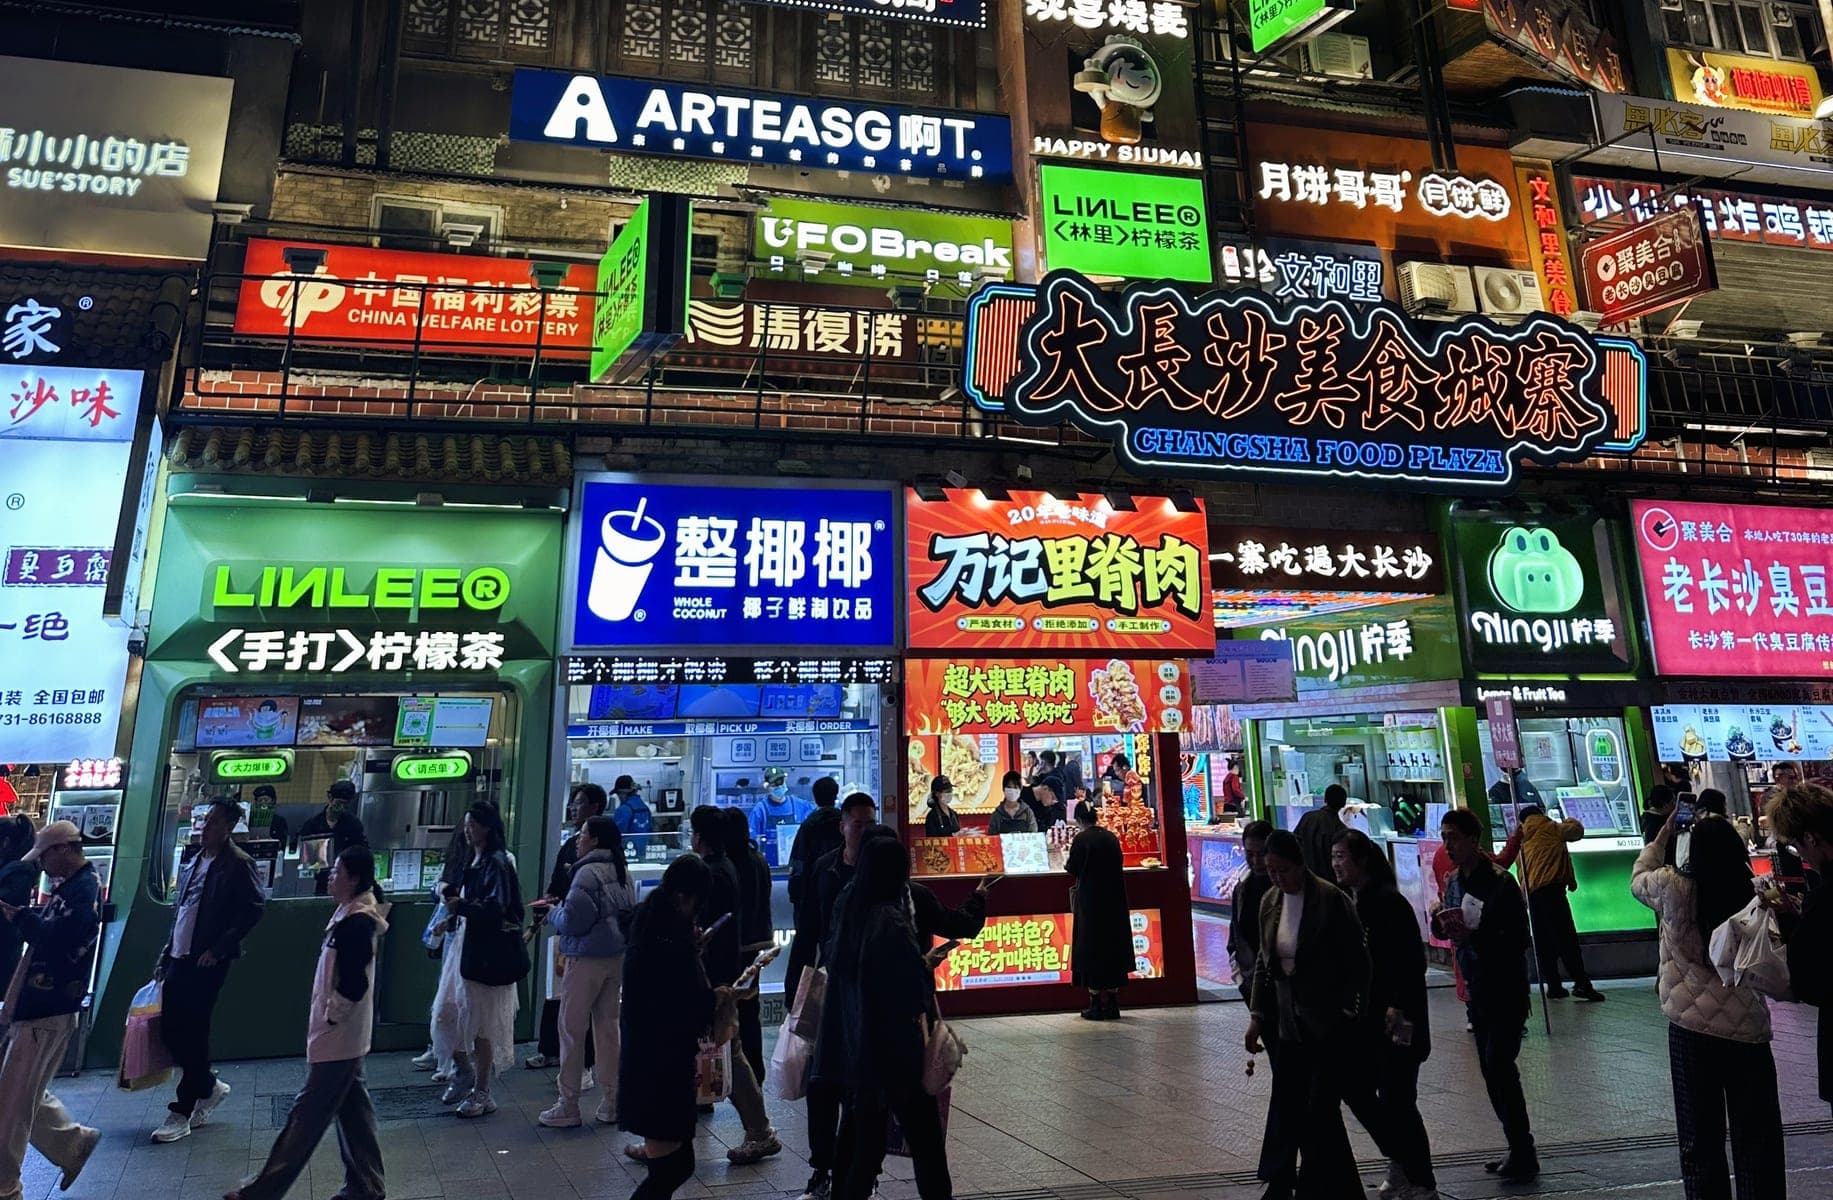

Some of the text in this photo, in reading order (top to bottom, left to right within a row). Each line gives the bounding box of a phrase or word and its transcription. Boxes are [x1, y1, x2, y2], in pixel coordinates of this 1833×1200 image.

[636, 88, 892, 151] ARTEASG
[1033, 136, 1201, 170] HAPPY SIUMAI
[1258, 161, 1405, 213] 月饼哥哥
[1529, 176, 1571, 316] 文和里美食
[1615, 234, 1673, 276] 聚美合
[1273, 252, 1383, 302] 文和里
[1602, 260, 1684, 305] 老长沙臭豆腐
[353, 270, 581, 320] 中国福利彩票
[2, 298, 61, 359] 家
[348, 309, 580, 337] CHINA WELFARE LOTTERY
[1030, 290, 1600, 442] 大長沙美食城寨
[10, 377, 121, 428] 沙味
[1134, 428, 1506, 474] CHANGSHA FOOD PLAZA
[1681, 520, 1734, 543] 聚美合
[674, 516, 873, 589] 整椰椰
[1208, 539, 1434, 580] 一寨吃遍大长沙
[920, 532, 1201, 615] 万记里脊肉
[1661, 556, 1833, 618] 老长沙臭豆
[672, 607, 728, 620] COCONUT
[673, 597, 713, 608] WHOLE
[742, 595, 873, 621] 椰子鲜制饮品
[967, 618, 1013, 629] 严选食材
[1044, 618, 1088, 630] 拒绝添加
[1117, 620, 1161, 631] 手工制作
[1571, 618, 1617, 644] 柠季
[1688, 629, 1833, 652] 长沙第一代臭豆腐传
[1361, 619, 1413, 664] 柠季
[33, 689, 105, 705] 全国包邮
[942, 663, 1076, 700] 超大串里脊肉
[1512, 686, 1522, 700] &
[1522, 686, 1547, 701] Fruit
[1547, 686, 1566, 701] Tea
[624, 726, 653, 736] MAKE
[719, 724, 741, 734] PICK
[744, 723, 758, 733] UP
[819, 720, 852, 731] ORDER
[985, 700, 1019, 727] 够味
